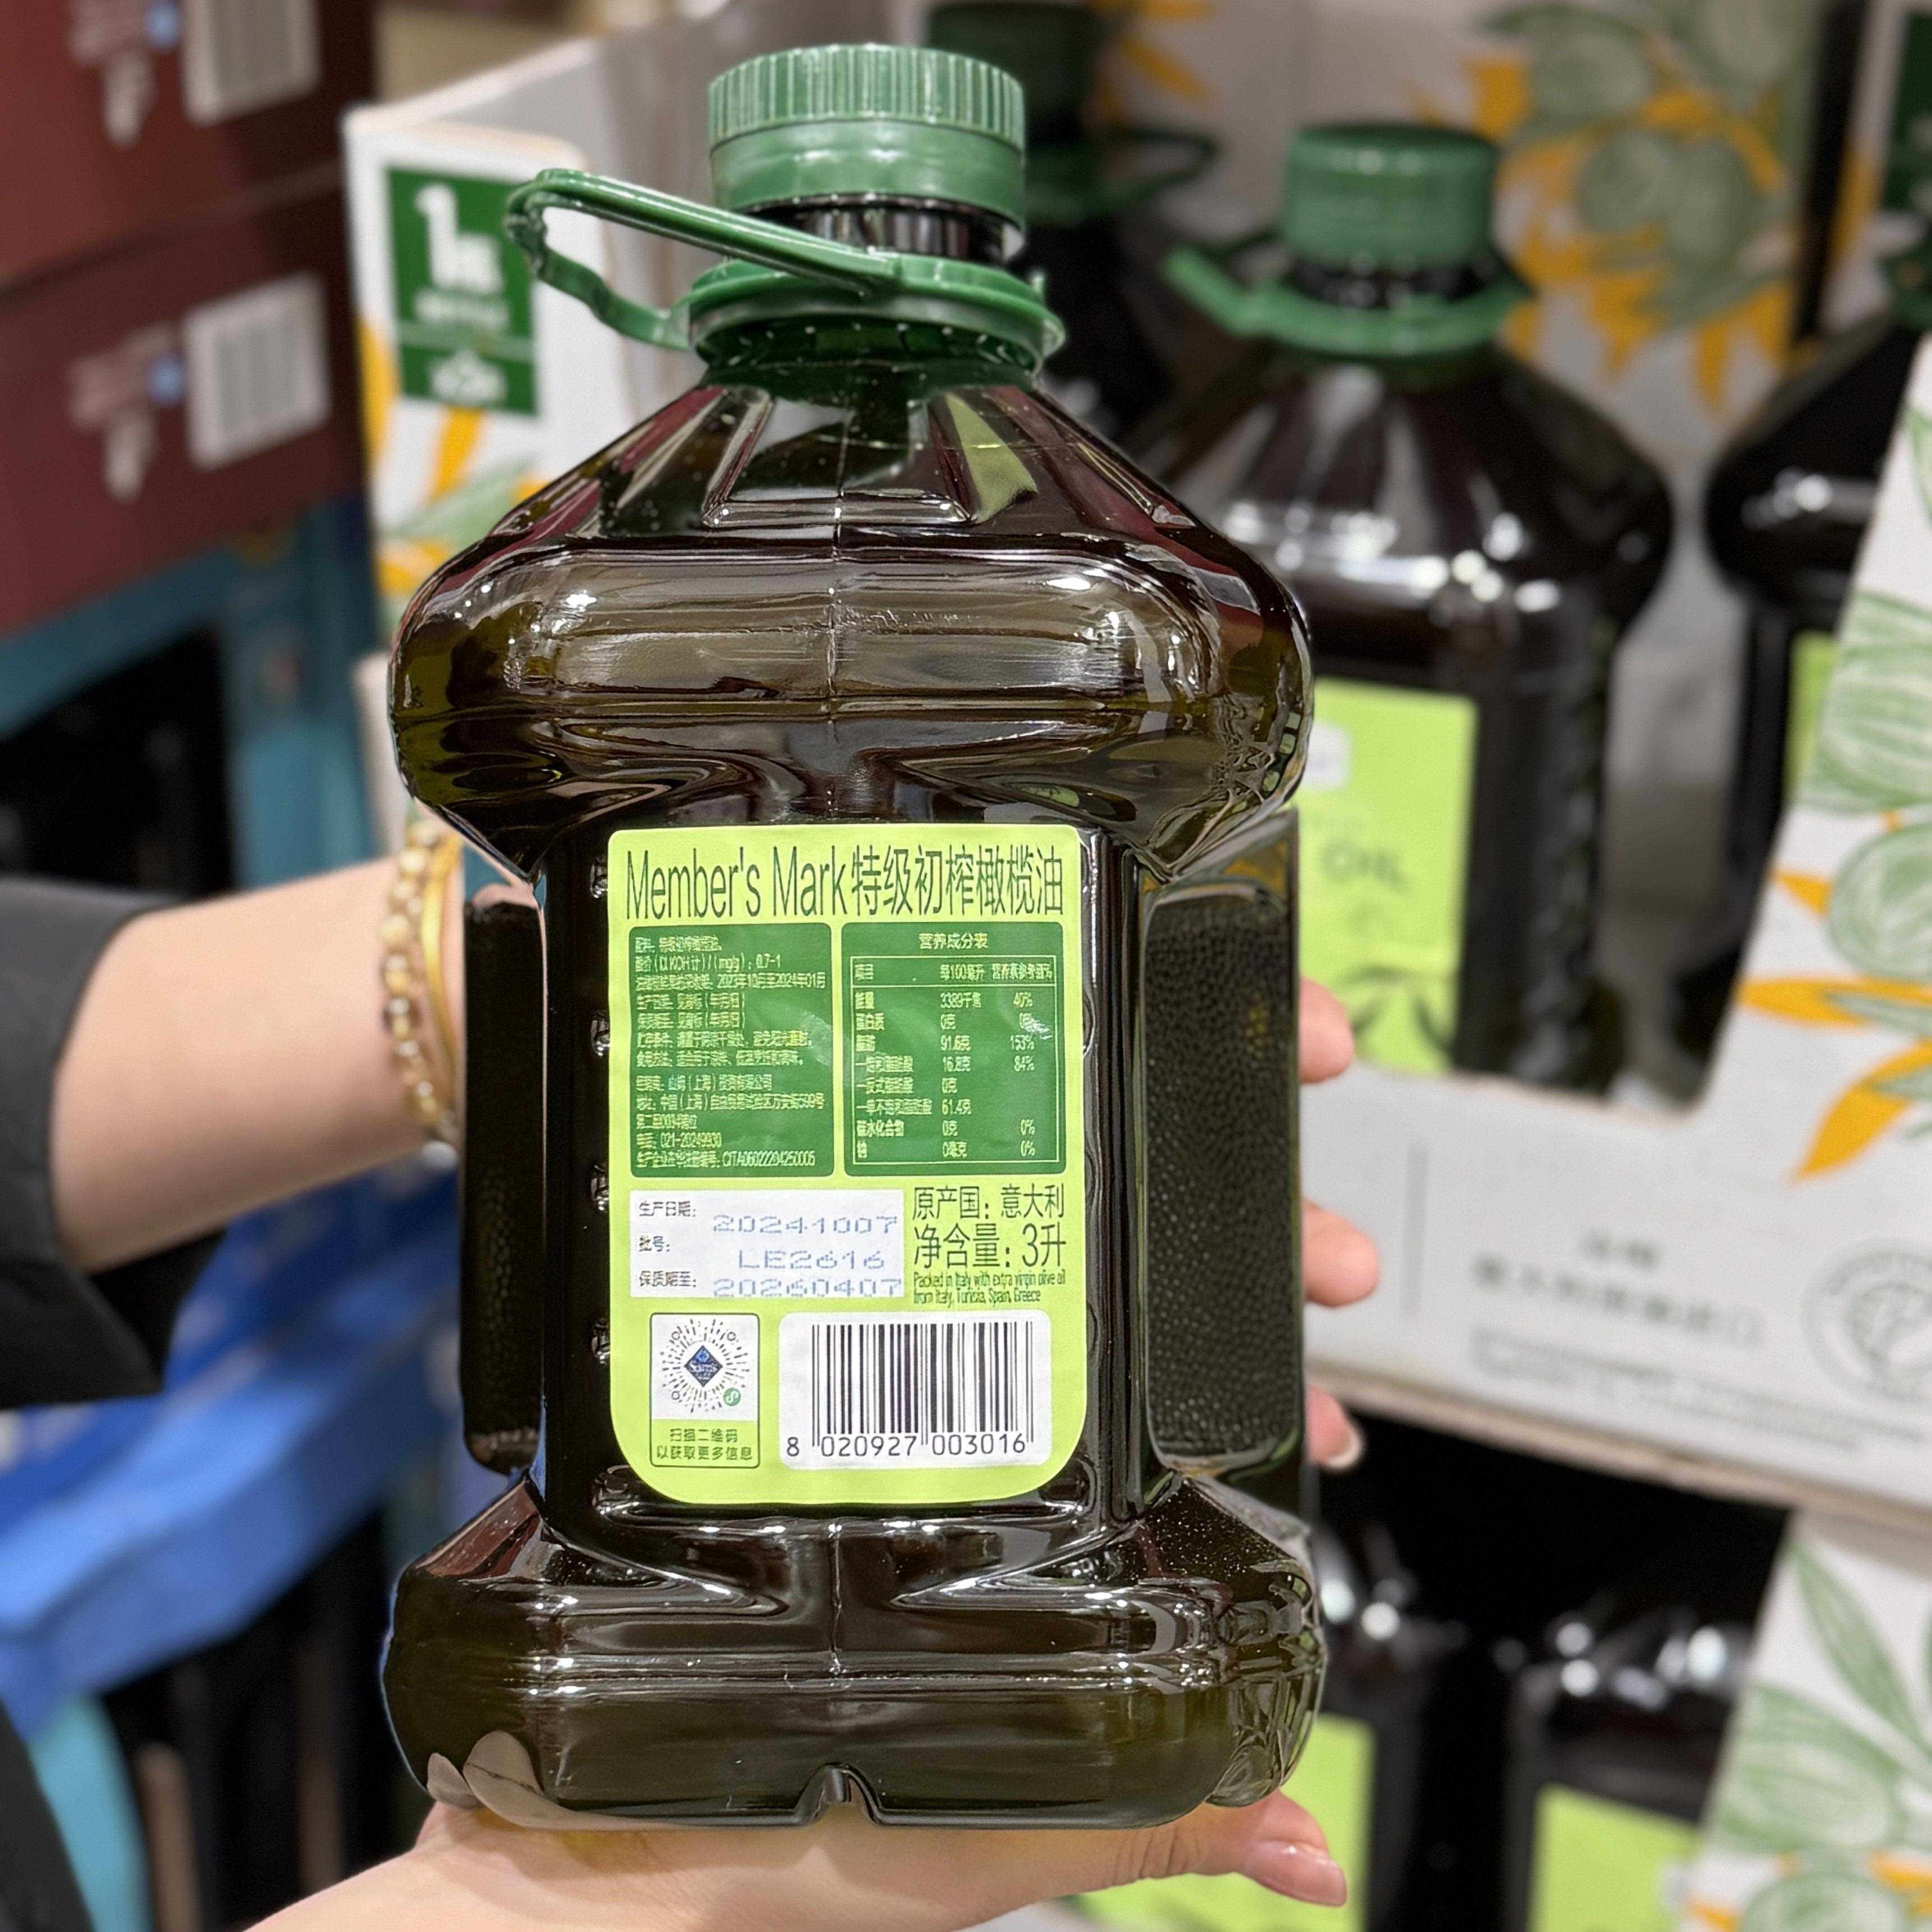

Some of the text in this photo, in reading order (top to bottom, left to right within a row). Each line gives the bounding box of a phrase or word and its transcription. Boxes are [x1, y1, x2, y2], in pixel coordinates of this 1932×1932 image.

[626, 846, 761, 920] Member's
[919, 932, 989, 950] 营养成分表
[713, 1214, 898, 1234] 20241007
[739, 1250, 884, 1270] LE2616
[713, 1279, 902, 1297] 20260407
[657, 1445, 753, 1461] 以获取更多信息
[786, 1433, 1026, 1457] 8 020927 003016
